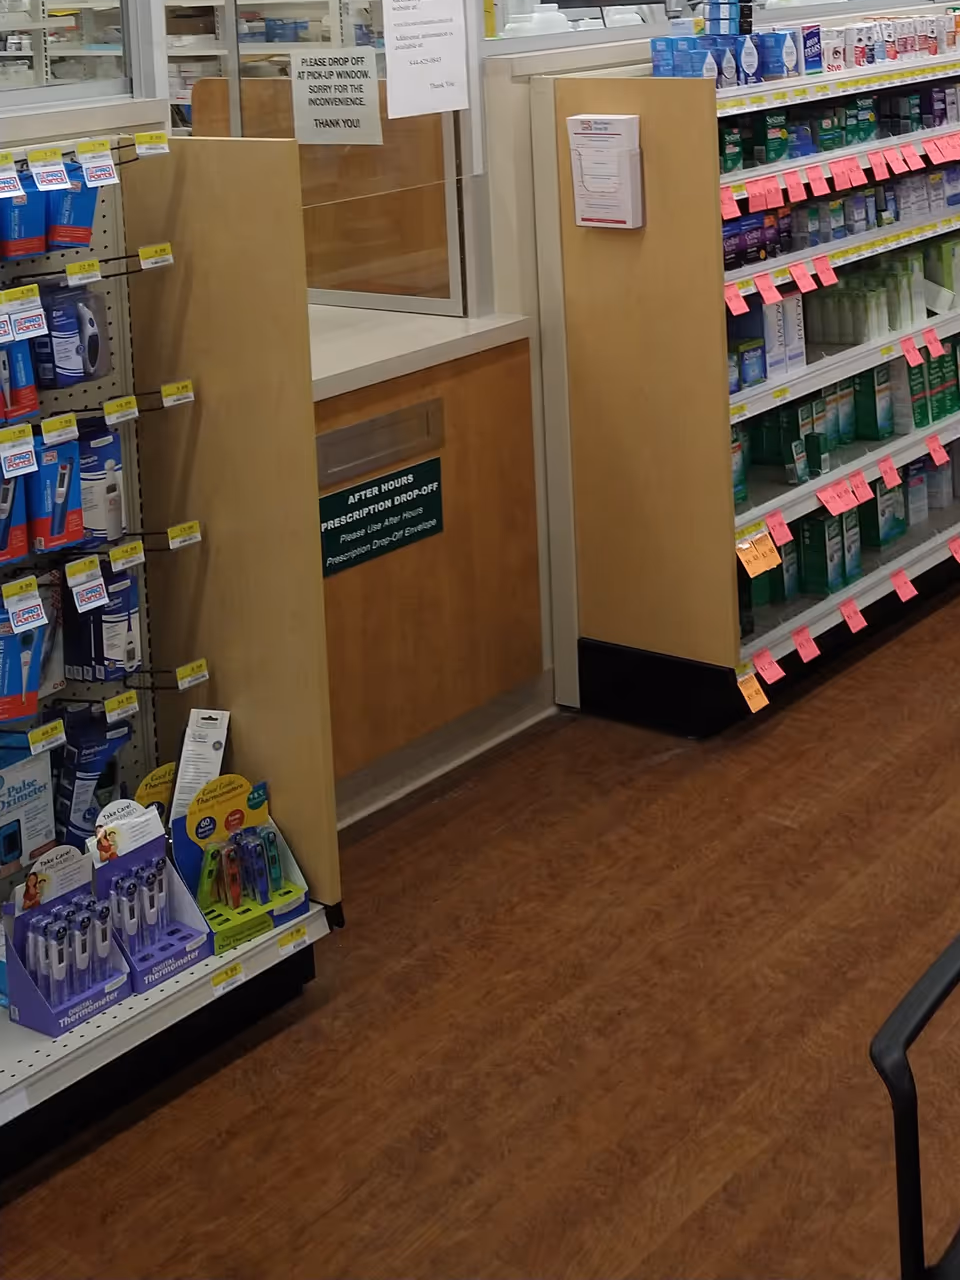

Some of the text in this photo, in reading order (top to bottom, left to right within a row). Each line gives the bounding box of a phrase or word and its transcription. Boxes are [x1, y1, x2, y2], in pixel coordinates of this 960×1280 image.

[301, 56, 365, 66] PLEASE DROP OFF
[297, 70, 305, 81] AT
[306, 70, 334, 81] PICK-UP
[308, 84, 364, 94] SORRY FOR THE
[314, 118, 361, 129] THANK YOU!
[24, 316, 40, 324] PRO
[13, 453, 30, 461] PRO
[8, 459, 32, 469] POINTS
[347, 473, 414, 505] AFTER HOURS
[320, 482, 439, 533] PRESCRIPTION DROP-OFF
[339, 506, 424, 544] Please Use After Hours
[326, 543, 371, 567] Prescription
[404, 518, 437, 536] Envelope
[85, 586, 101, 596] PRO
[80, 592, 103, 603] POINTS
[22, 606, 39, 617] PRO
[16, 614, 41, 624] POINTS
[7, 778, 37, 798] Pulse
[103, 810, 117, 821] Take
[116, 802, 132, 815] Care!
[200, 817, 210, 827] 60
[40, 858, 53, 868] Take
[55, 848, 71, 860] Care!
[144, 949, 199, 984] Thermometer
[152, 956, 175, 973] DIGITAL
[58, 990, 119, 1028] Thermometer
[68, 998, 94, 1016] DIGITAL
